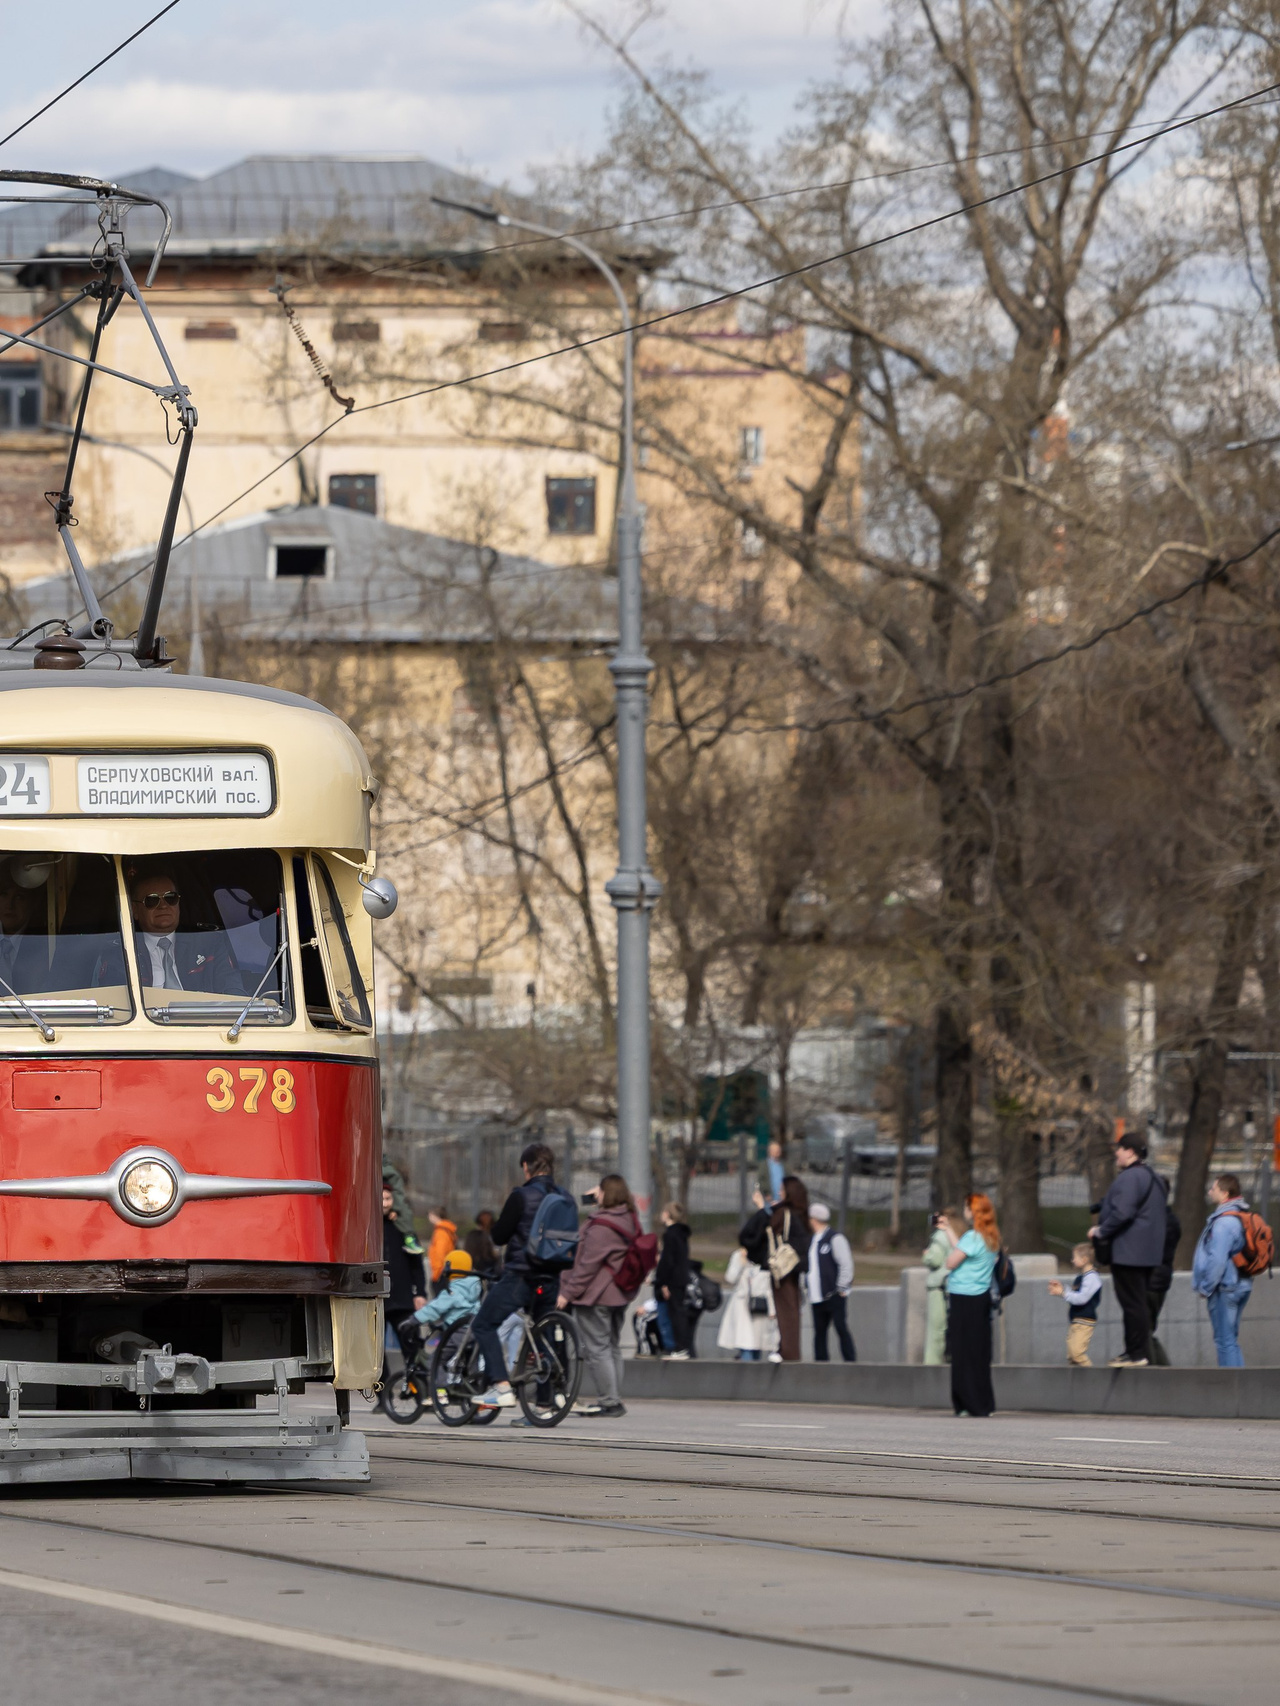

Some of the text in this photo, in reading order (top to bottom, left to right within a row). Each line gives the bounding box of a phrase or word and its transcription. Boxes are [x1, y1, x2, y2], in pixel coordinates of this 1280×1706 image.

[87, 765, 214, 783] СЕРПУХОВСКИЙ
[88, 787, 217, 805] ВЛАДИМИРСКИЙ
[206, 1066, 297, 1114] 378
